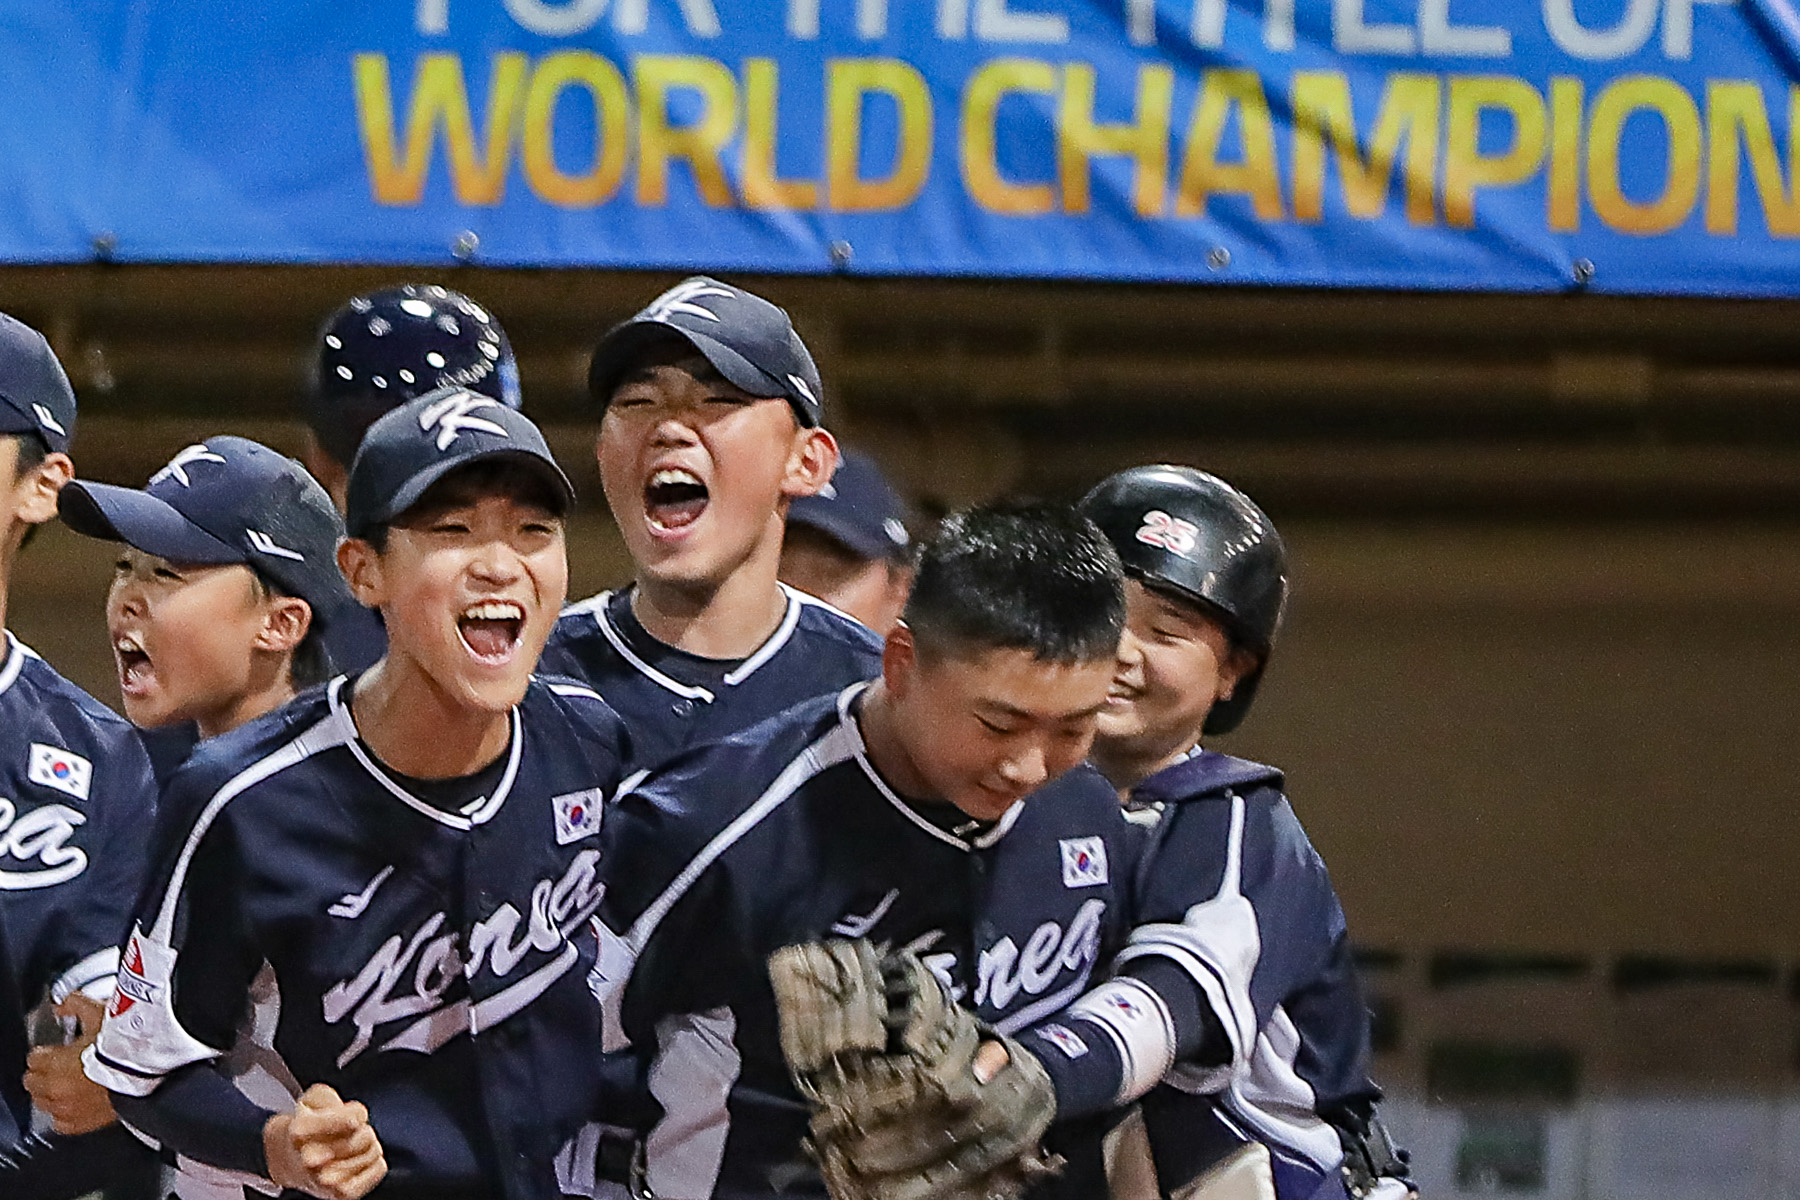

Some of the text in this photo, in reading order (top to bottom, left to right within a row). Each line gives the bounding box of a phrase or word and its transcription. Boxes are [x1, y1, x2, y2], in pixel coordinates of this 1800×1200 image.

[352, 50, 1800, 239] WORLD CHAMPION
[1135, 509, 1200, 553] 25
[322, 849, 607, 1069] Korea
